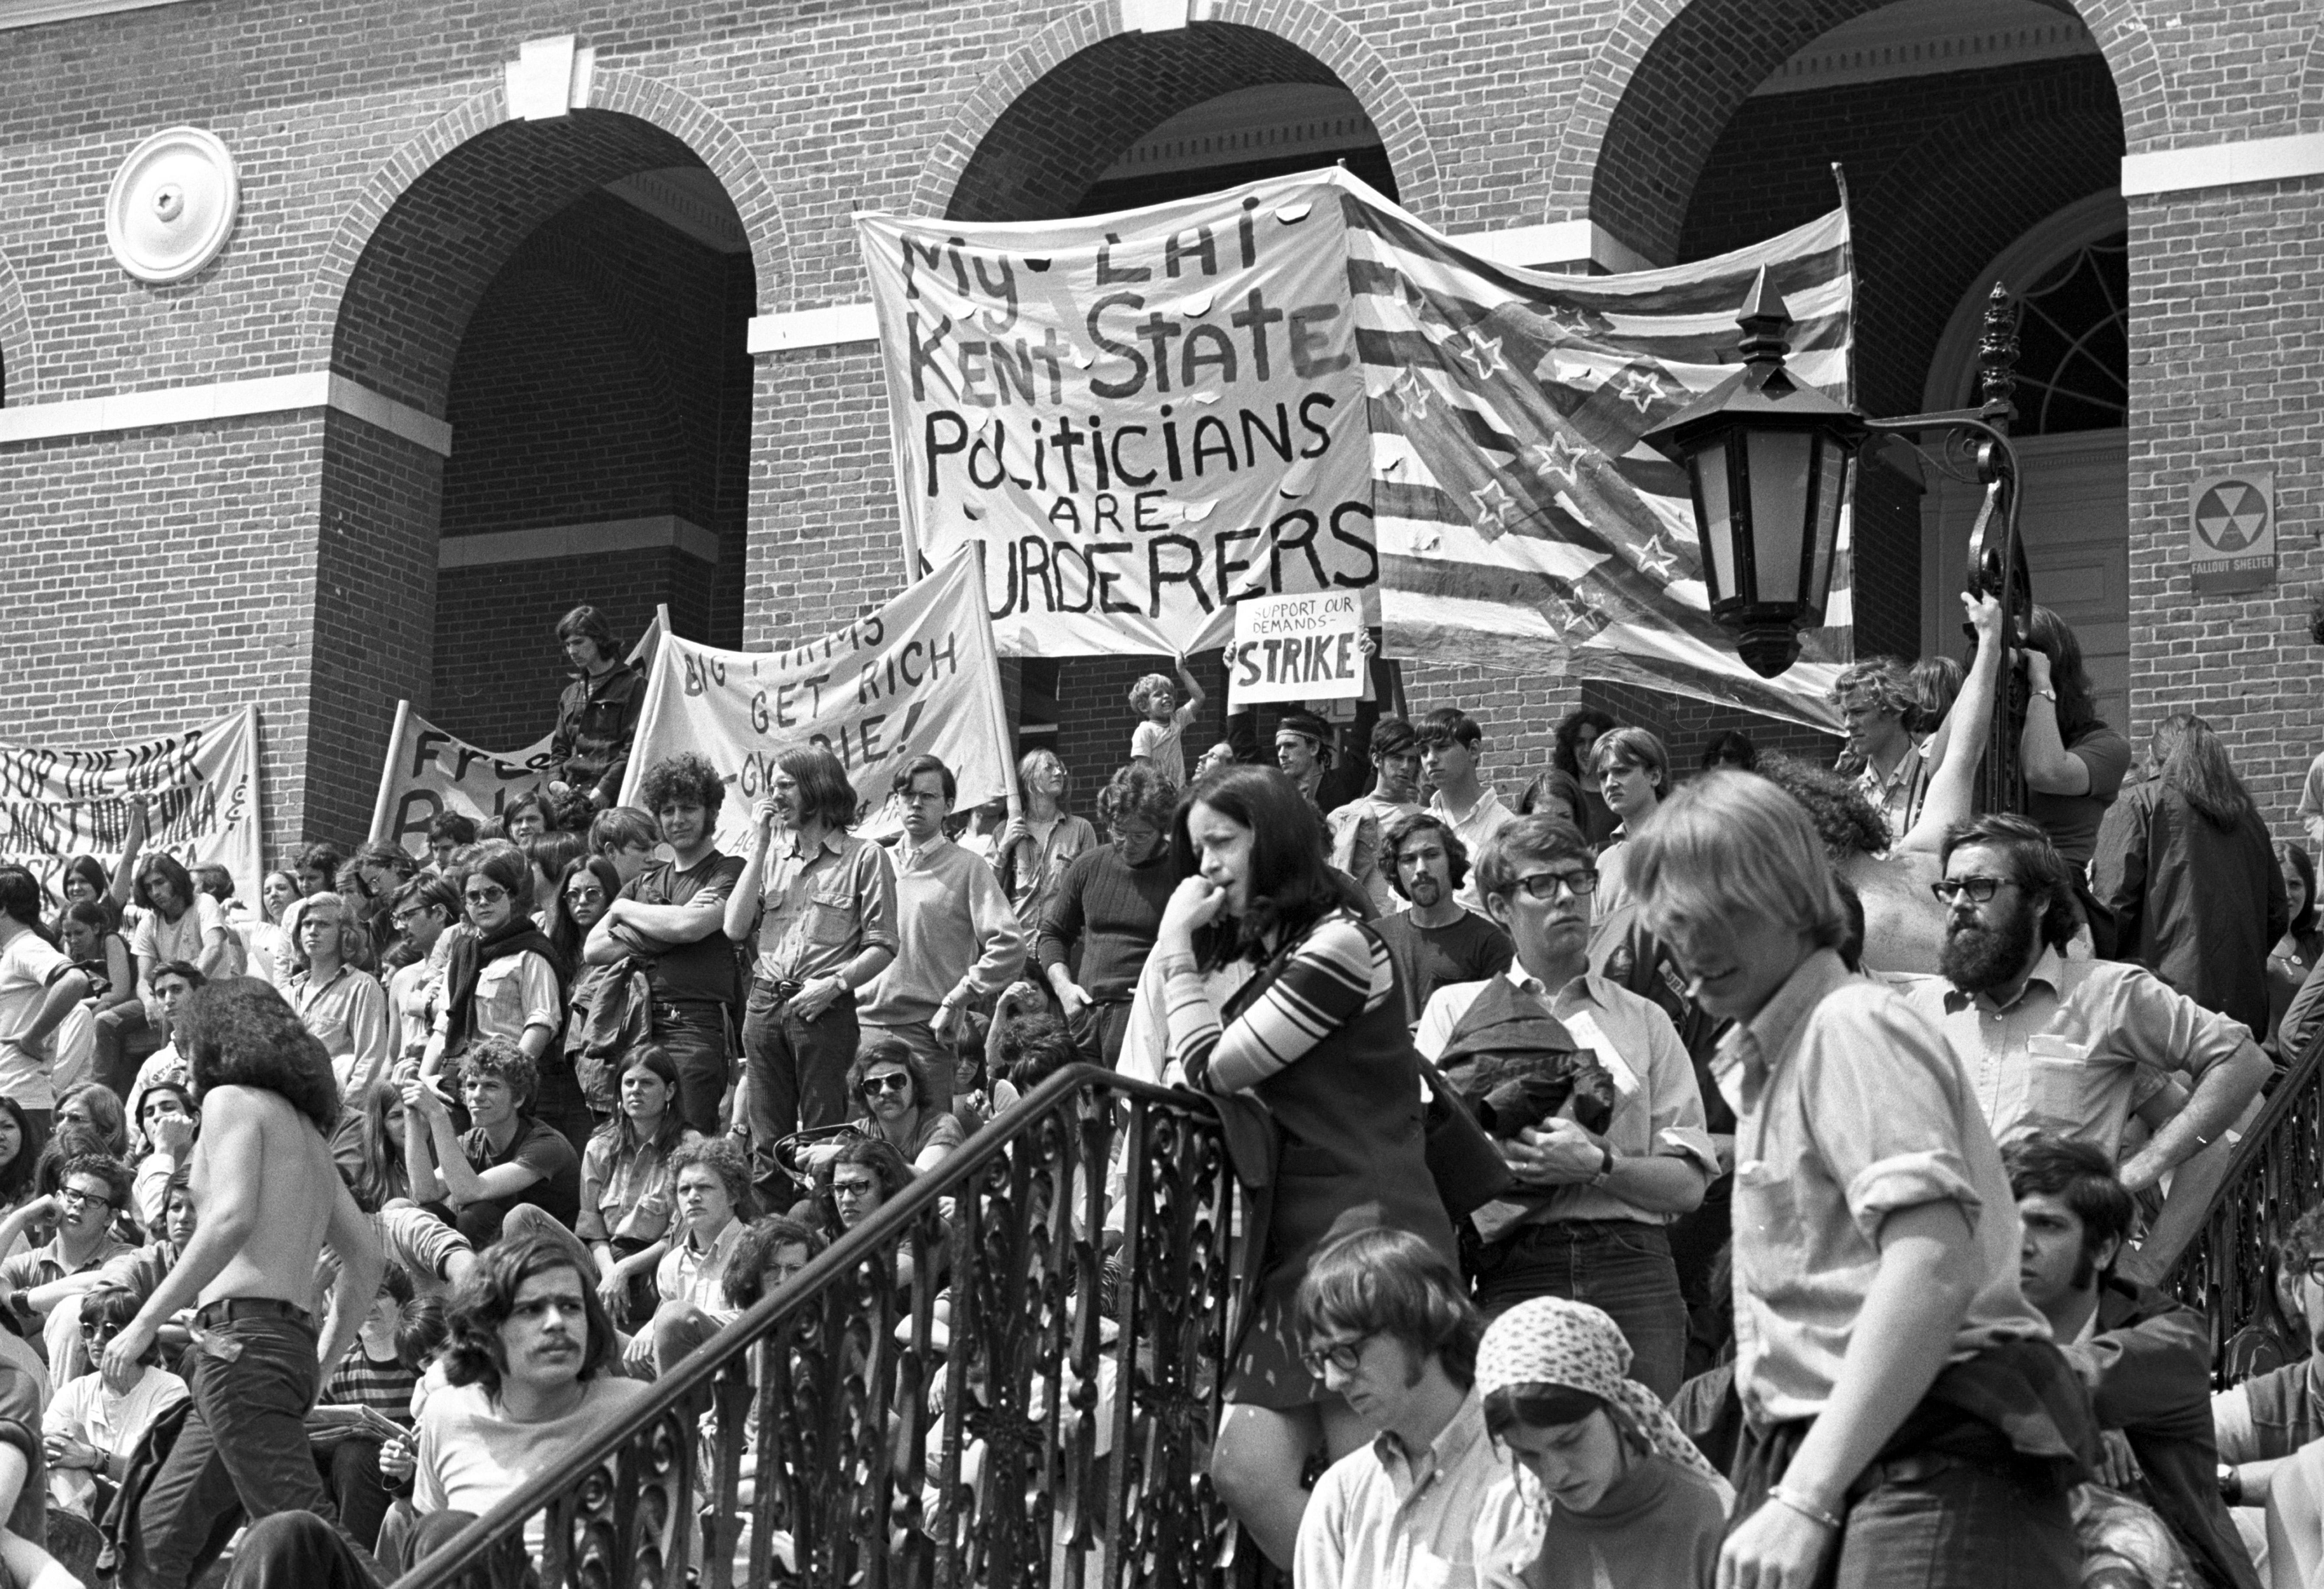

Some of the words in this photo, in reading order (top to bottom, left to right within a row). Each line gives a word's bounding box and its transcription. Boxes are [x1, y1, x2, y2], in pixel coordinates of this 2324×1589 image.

[899, 231, 1018, 334] My
[1049, 489, 1172, 533] ARE
[918, 501, 1379, 619] URDERERS
[2191, 560, 2230, 574] FALLOUT
[2233, 557, 2274, 571] SHELTER
[1254, 600, 1316, 621] SUPPORT
[1325, 597, 1354, 613] OUR
[684, 651, 726, 697] BIG
[752, 673, 830, 734] GET
[859, 631, 956, 705] RICH
[1237, 631, 1355, 687] STRIKE
[62, 749, 118, 798] THE
[124, 730, 204, 791] WAR
